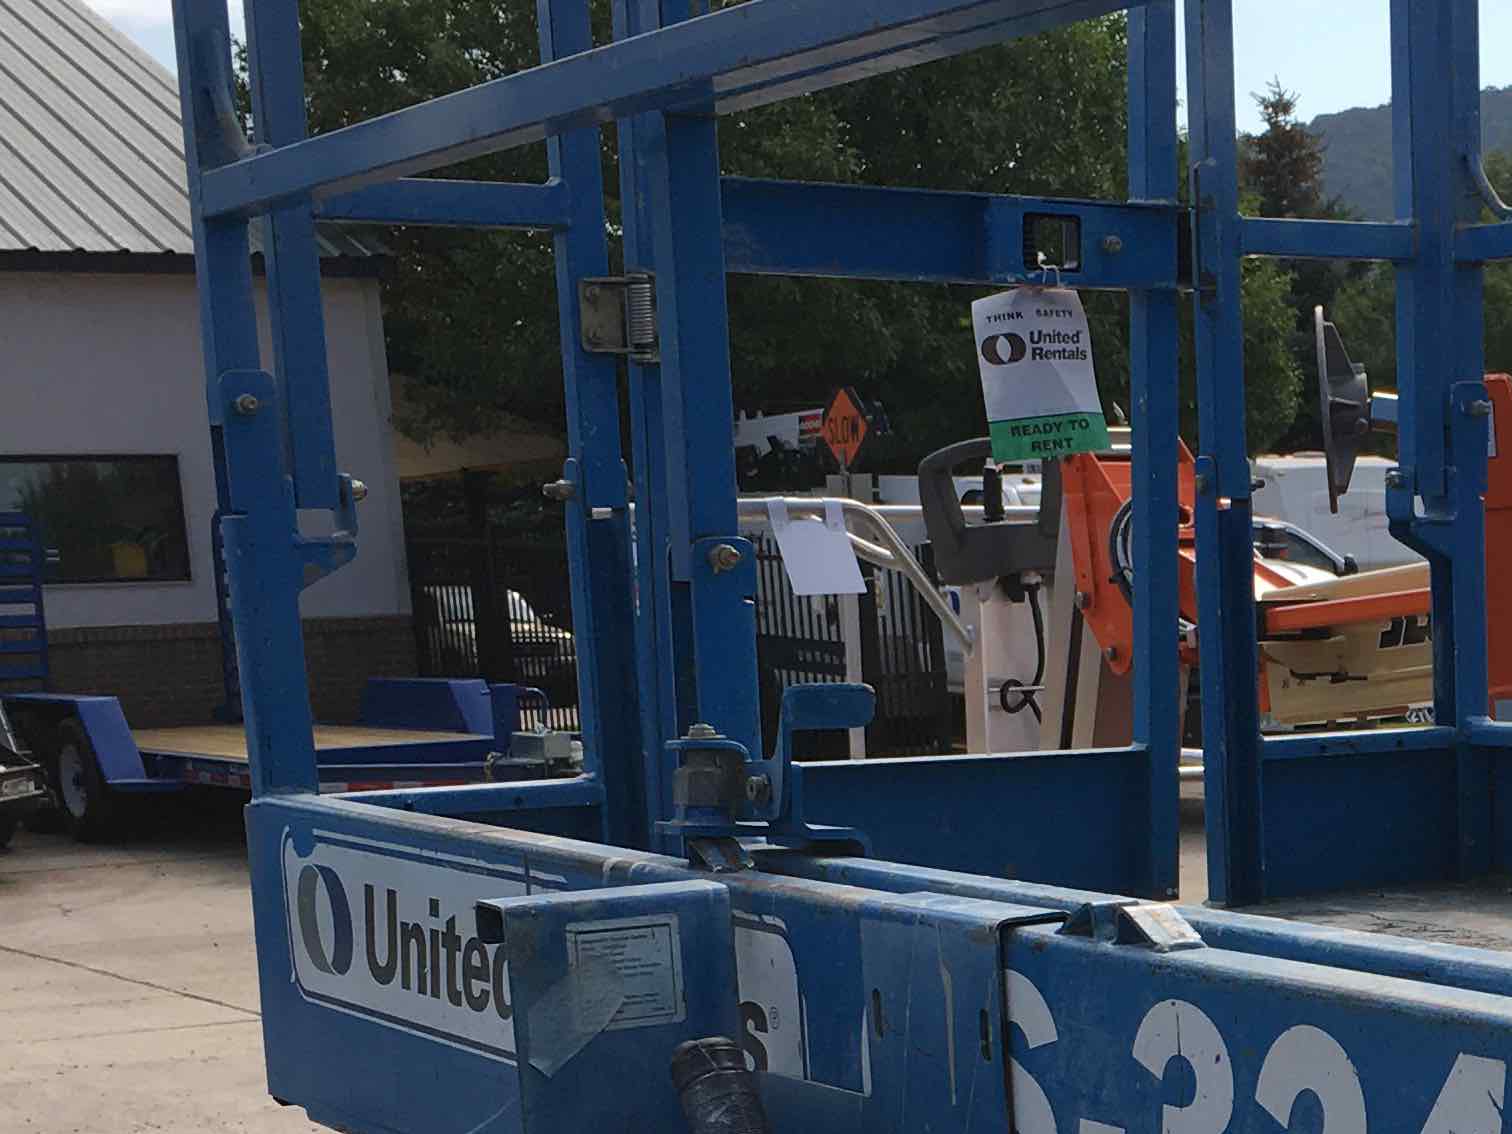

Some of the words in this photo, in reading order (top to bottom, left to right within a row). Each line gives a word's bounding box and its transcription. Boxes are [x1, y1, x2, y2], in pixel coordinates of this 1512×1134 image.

[985, 311, 1024, 323] THINK
[1035, 308, 1073, 319] SAFETY
[1029, 330, 1081, 345] United
[1031, 347, 1087, 361] Rentals
[827, 415, 861, 445] SLOW
[1010, 421, 1063, 437] READY
[1068, 418, 1090, 431] TO
[1031, 437, 1073, 452] RENT
